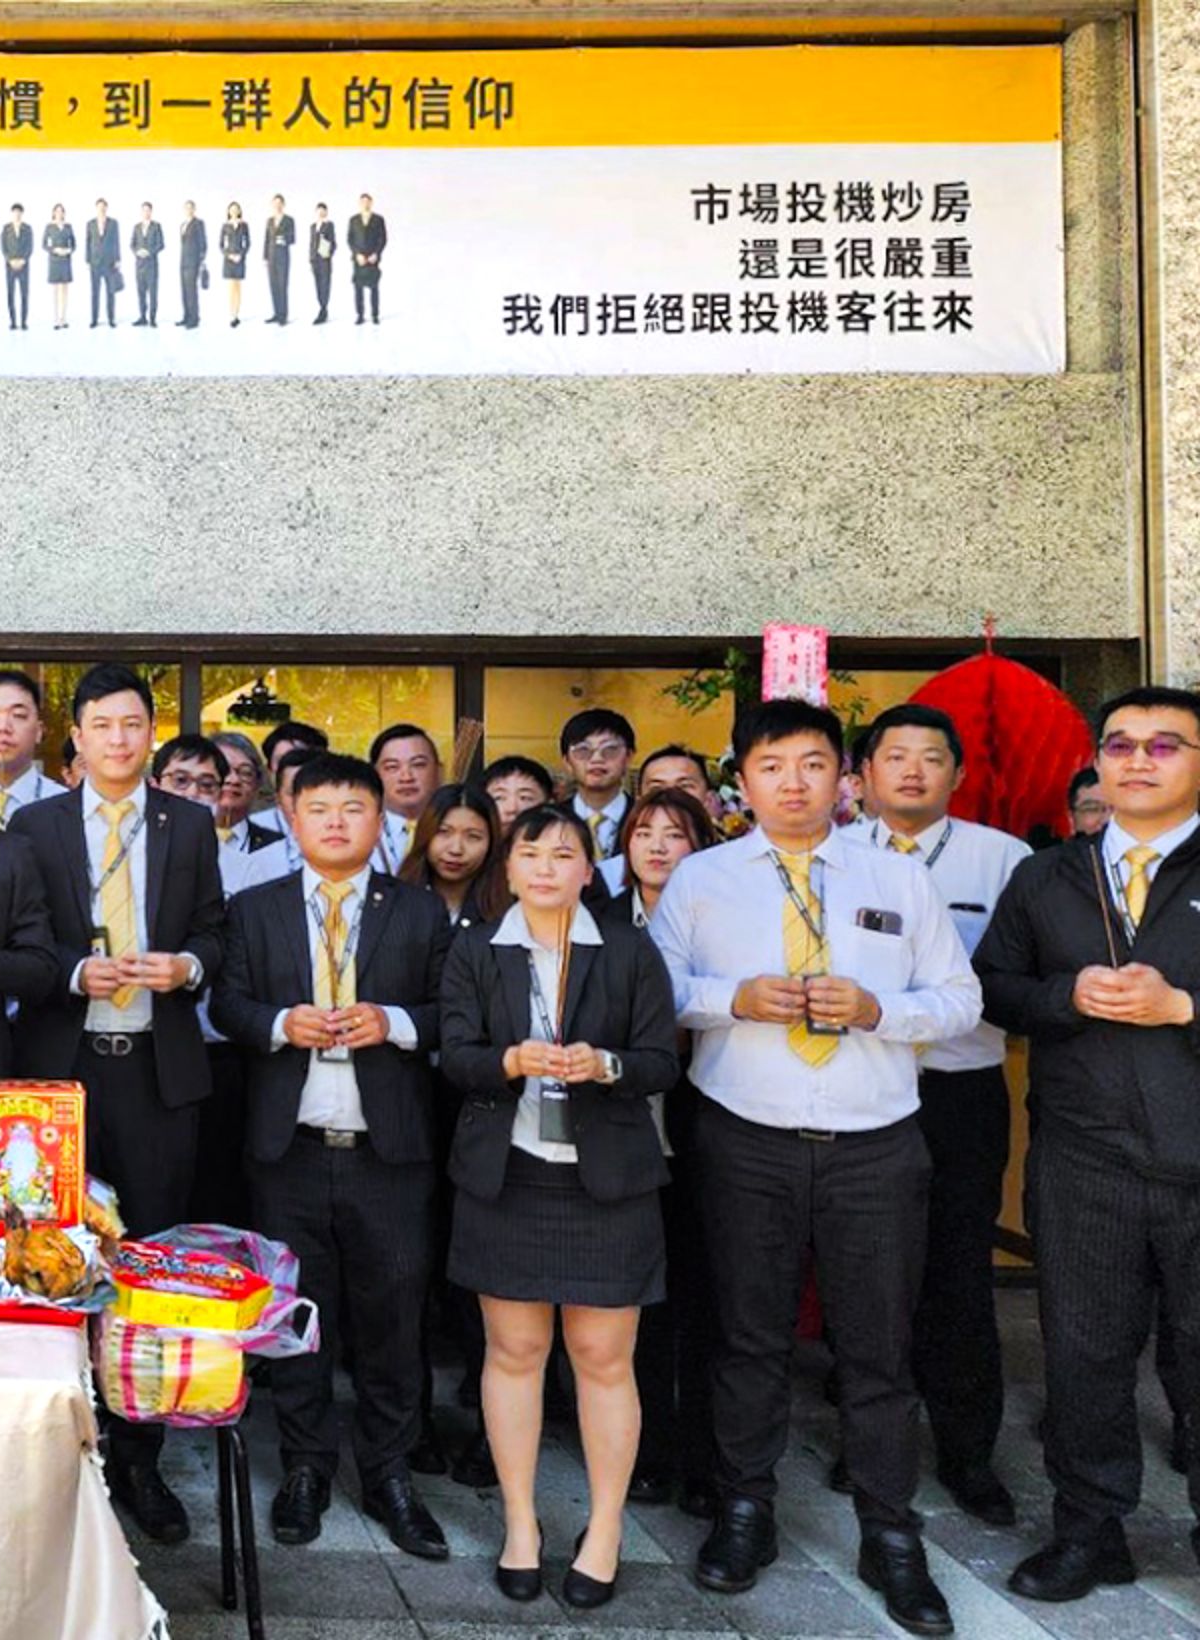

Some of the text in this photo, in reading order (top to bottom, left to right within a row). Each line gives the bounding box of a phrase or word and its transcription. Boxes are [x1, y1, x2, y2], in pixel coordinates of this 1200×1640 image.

[690, 181, 972, 225] 市場投機炒房
[738, 236, 973, 280] 還是很嚴重
[503, 290, 974, 336] 我們拒絕跟投機客往來
